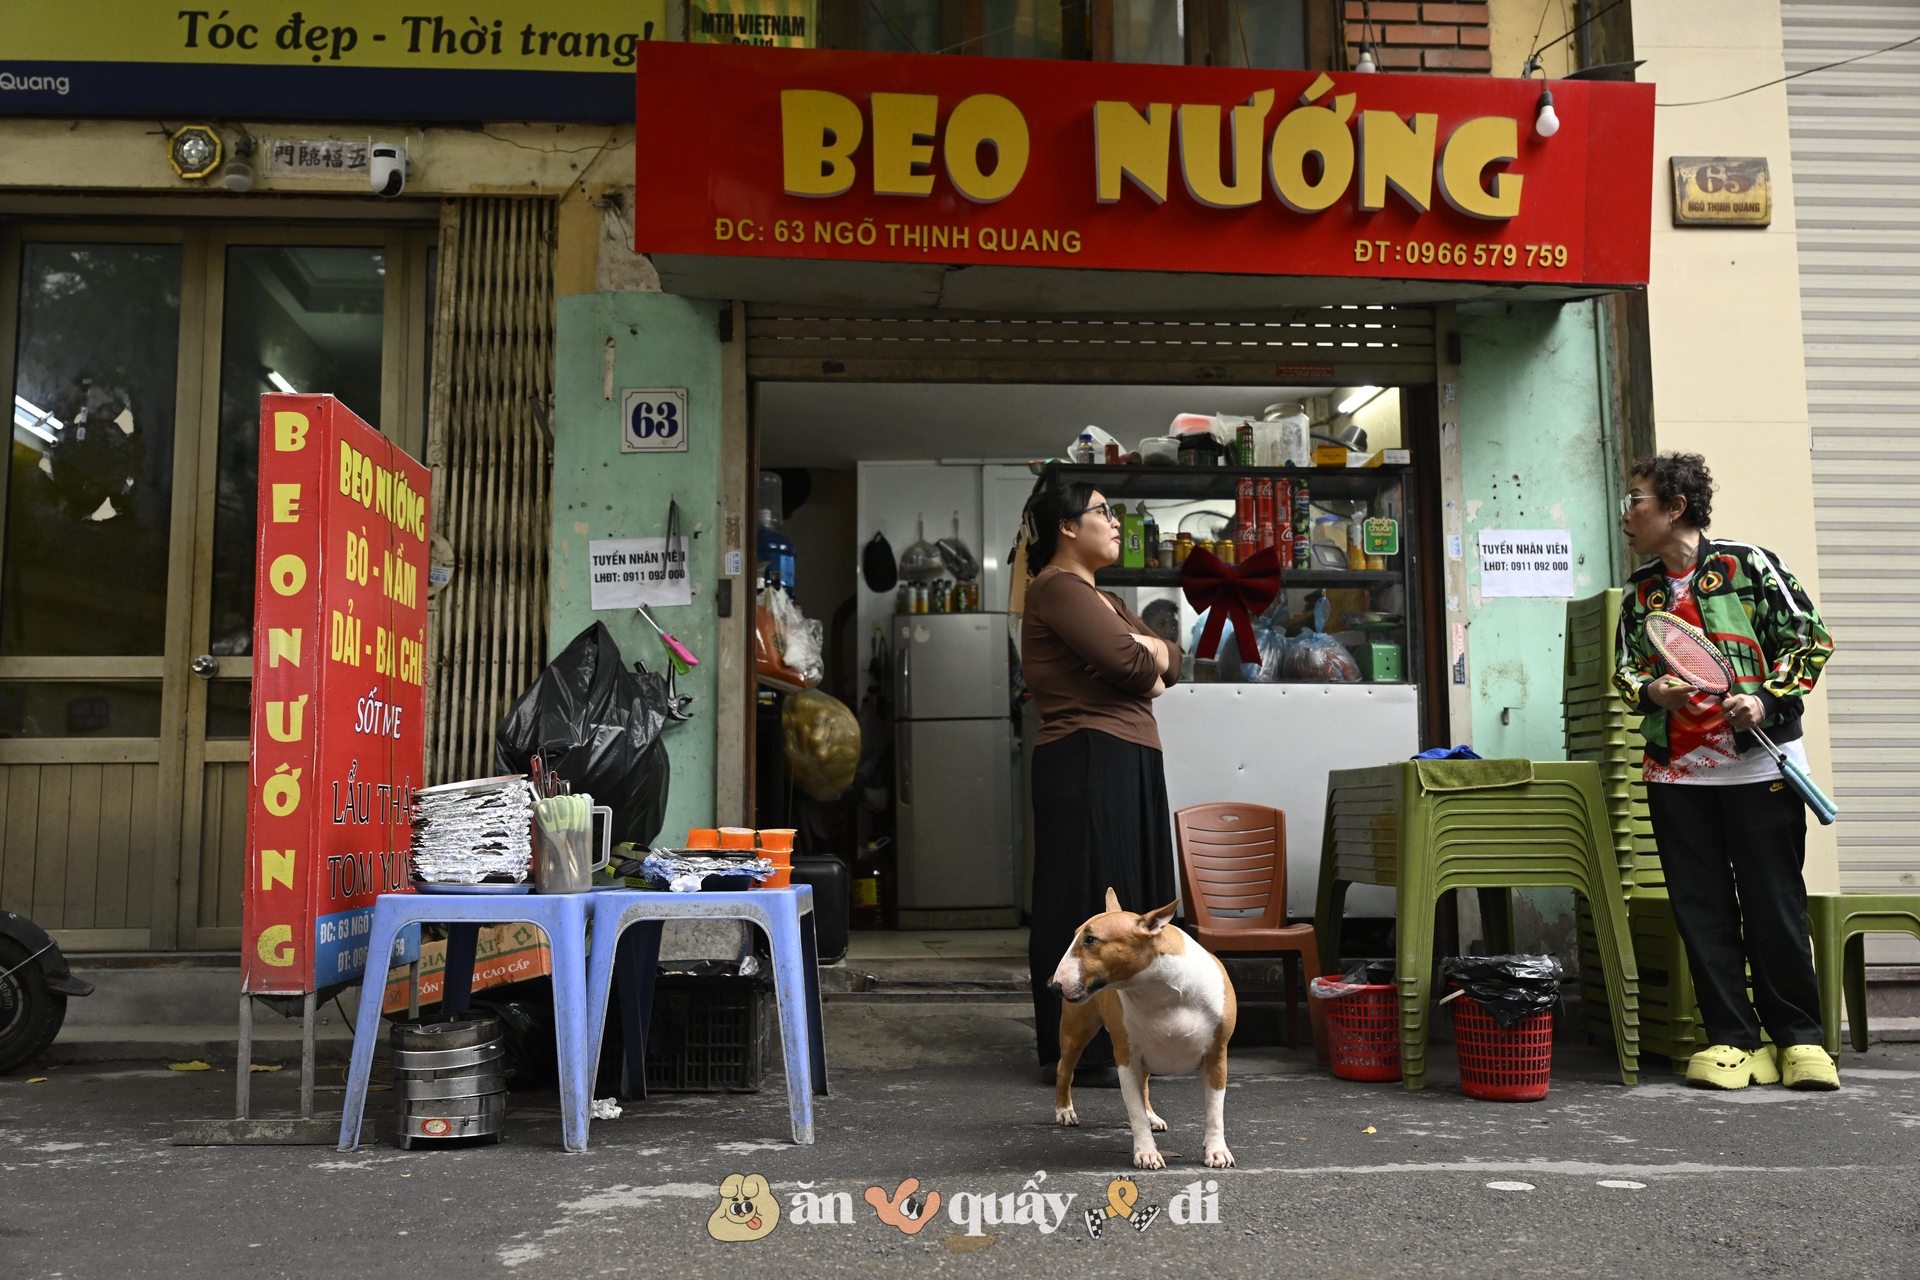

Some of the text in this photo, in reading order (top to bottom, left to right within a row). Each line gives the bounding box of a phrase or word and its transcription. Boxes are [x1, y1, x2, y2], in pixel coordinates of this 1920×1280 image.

[178, 10, 259, 50] Tóc
[275, 12, 358, 63] đẹp
[402, 15, 503, 55] Thời
[702, 13, 805, 37] MTH VIETNAM
[0, 72, 70, 95] Quang
[781, 72, 1524, 219] BEO NƯỚNG
[1696, 164, 1751, 194] 65
[1733, 202, 1760, 213] QUANG
[715, 218, 1081, 253] ĐC: 63 NGÕ THỊNH QUANG
[1473, 244, 1517, 267] 579
[1525, 245, 1568, 268] 759
[631, 402, 679, 438] 63
[340, 439, 425, 543] BEO NƯỚNG
[593, 550, 626, 566] TUYỂN
[629, 551, 658, 565] NHÂN
[1482, 540, 1568, 554] TUYỂN NHÂN VIÊN
[346, 525, 369, 586] BÒ
[383, 543, 417, 610] NẦM
[595, 569, 685, 583] LHĐT: 0911 092 000
[1484, 561, 1568, 571] LHĐT: 0911 092 000
[331, 598, 361, 667] DẢI
[376, 626, 396, 678] BA
[400, 628, 423, 686] CHỈ
[355, 685, 402, 739] SỐT ME
[332, 759, 417, 825] LẨU THÁ
[327, 851, 373, 899] TOM
[320, 922, 336, 945] ĐC:
[338, 918, 349, 940] 63
[351, 910, 369, 937] NGÕ
[337, 950, 351, 973] ĐT:
[420, 951, 445, 970] GIA
[484, 966, 506, 980] CAO
[508, 958, 530, 974] CẤP
